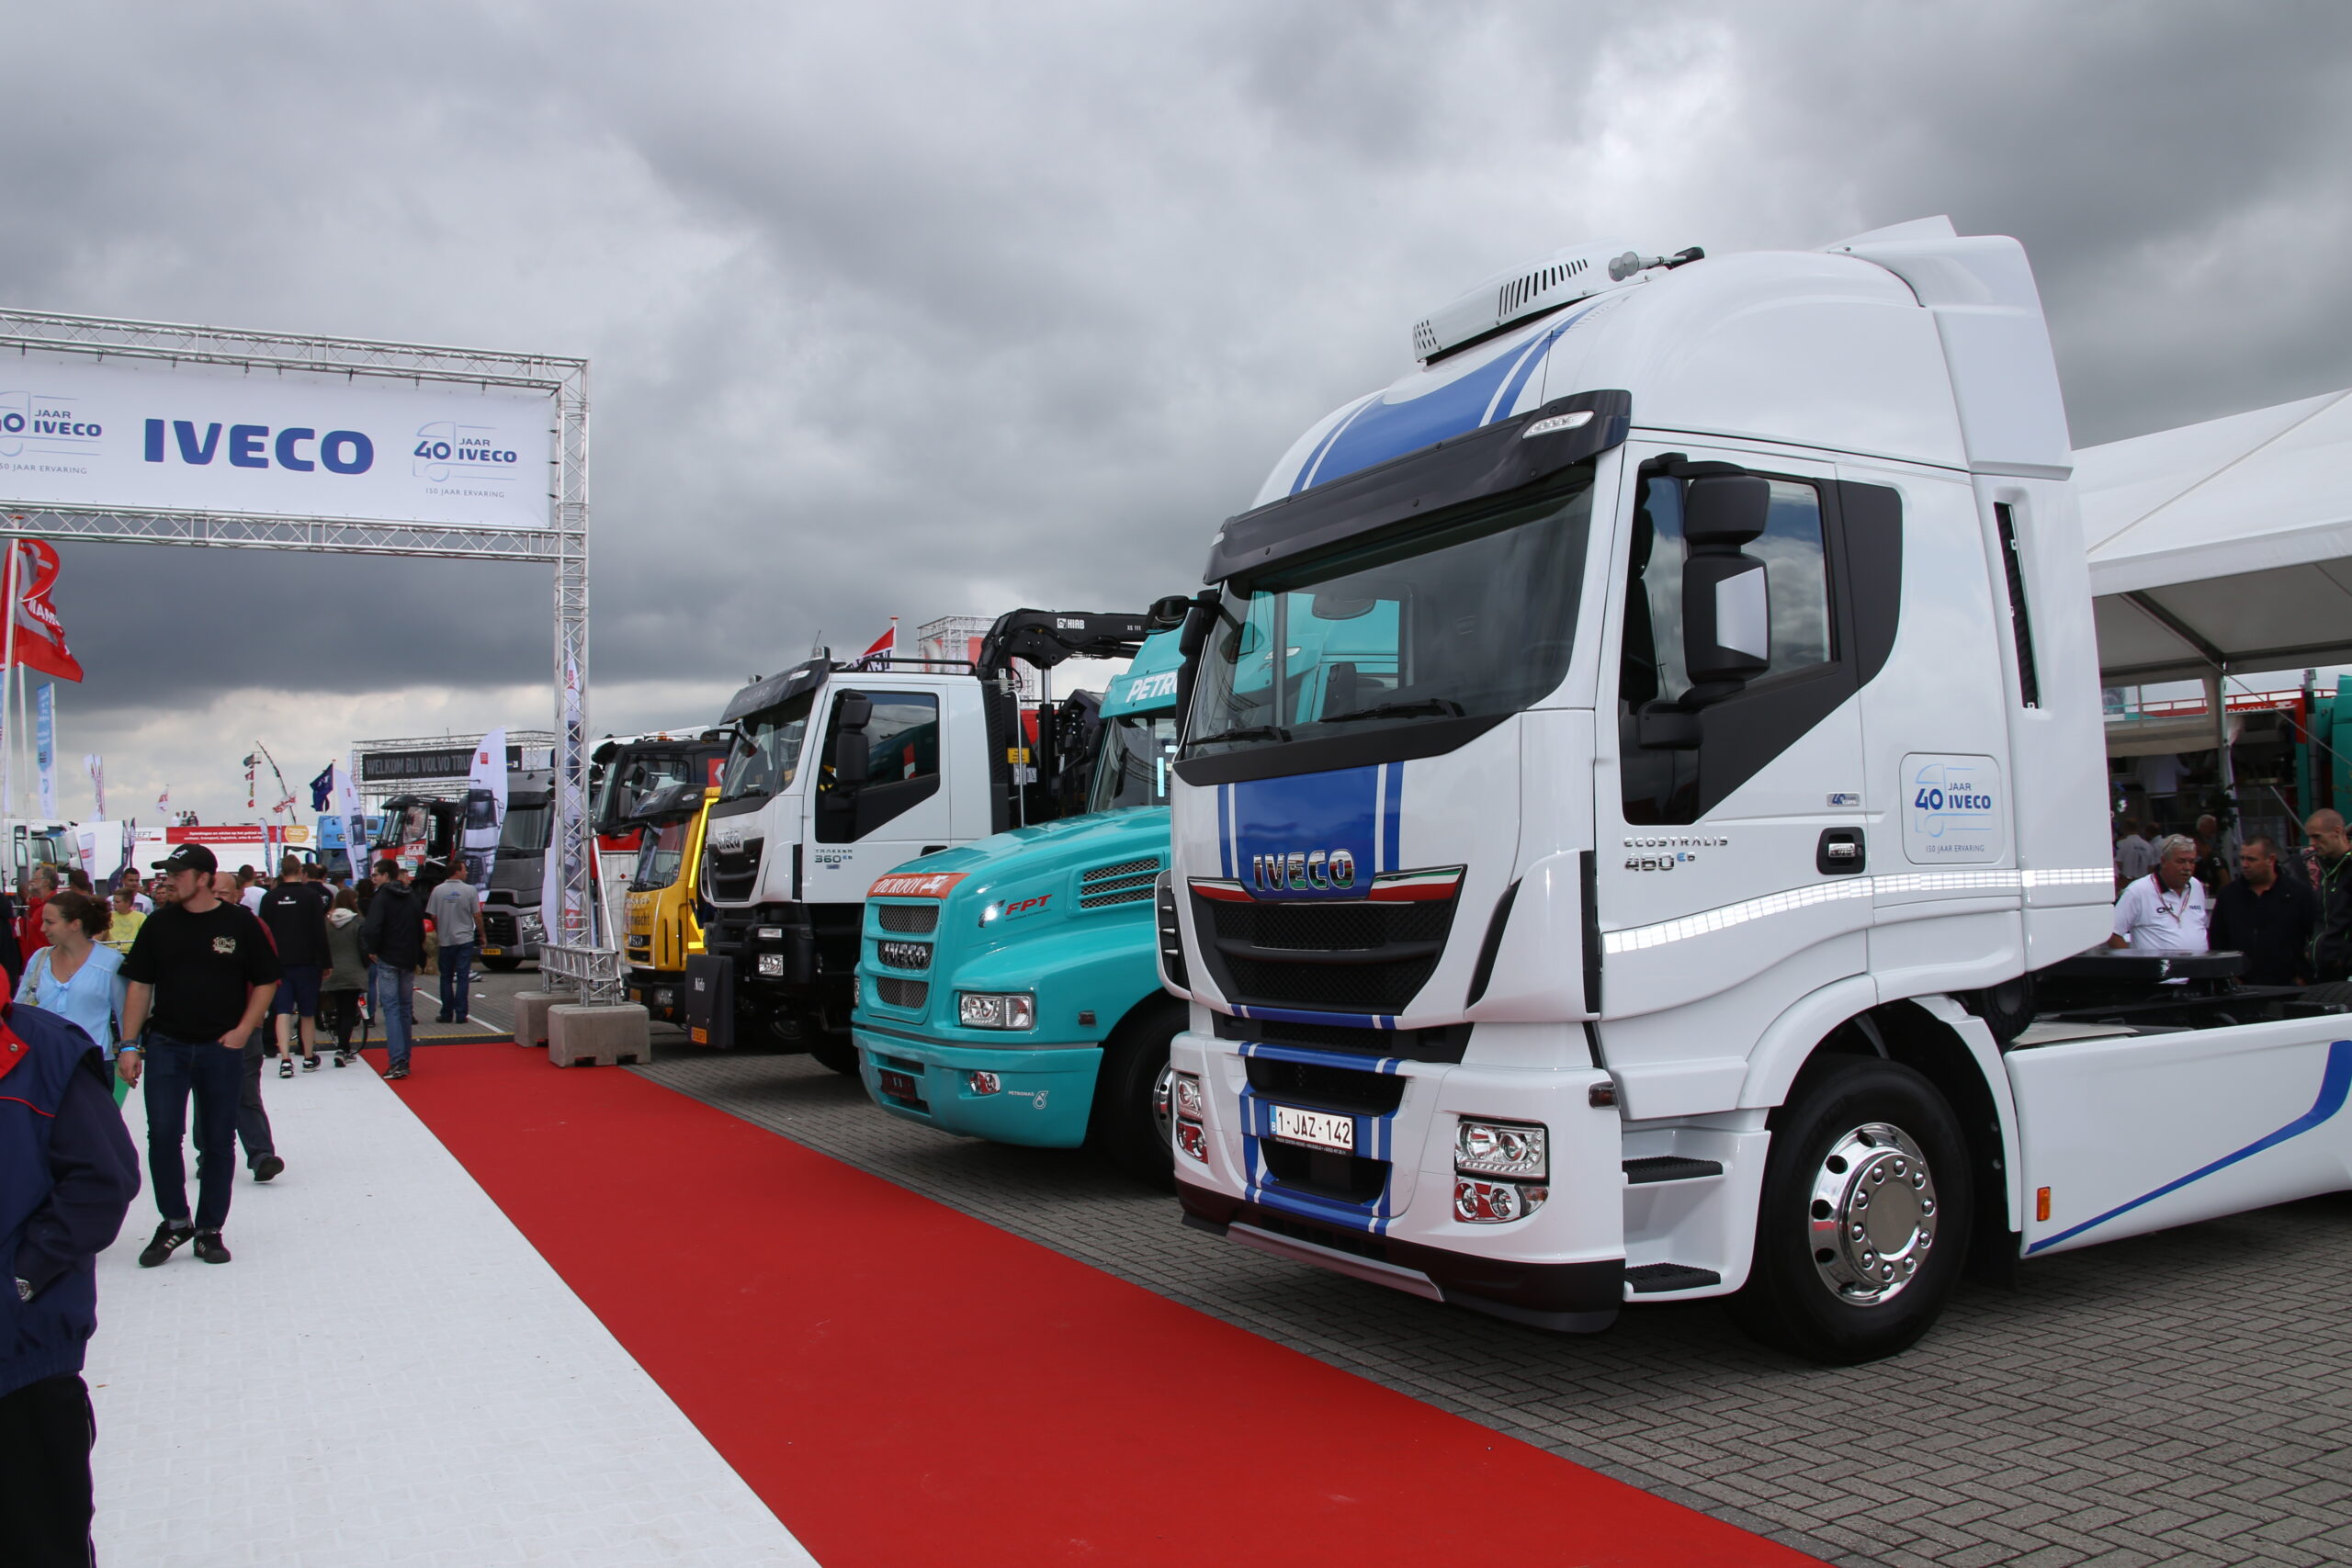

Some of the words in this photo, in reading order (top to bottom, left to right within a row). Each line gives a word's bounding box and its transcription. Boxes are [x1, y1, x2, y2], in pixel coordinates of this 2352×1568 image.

[34, 409, 72, 419] JAAR
[0, 412, 26, 433] 0
[34, 420, 103, 437] IVECO
[144, 418, 374, 475] IVECO
[458, 438, 492, 446] JAAR
[413, 440, 451, 460] 40
[458, 447, 517, 463] IVECO
[40, 465, 87, 475] ERVARING
[463, 490, 505, 498] ERVARING
[1067, 619, 1085, 630] HIAB
[368, 759, 404, 774] WELKOM
[421, 756, 450, 773] VOLVO
[1948, 782, 1972, 791] JAAR
[1914, 788, 1943, 810] 40
[1949, 795, 1992, 810] IVECO
[1623, 836, 1728, 848] ECOSTRALIS
[1937, 845, 1953, 854] JAAR
[1954, 844, 1984, 853] ERVARING
[814, 855, 842, 863] 360
[1624, 852, 1675, 872] 460
[1252, 848, 1355, 892] IVECO
[1005, 894, 1053, 916] FPT
[884, 942, 927, 968] IVECO
